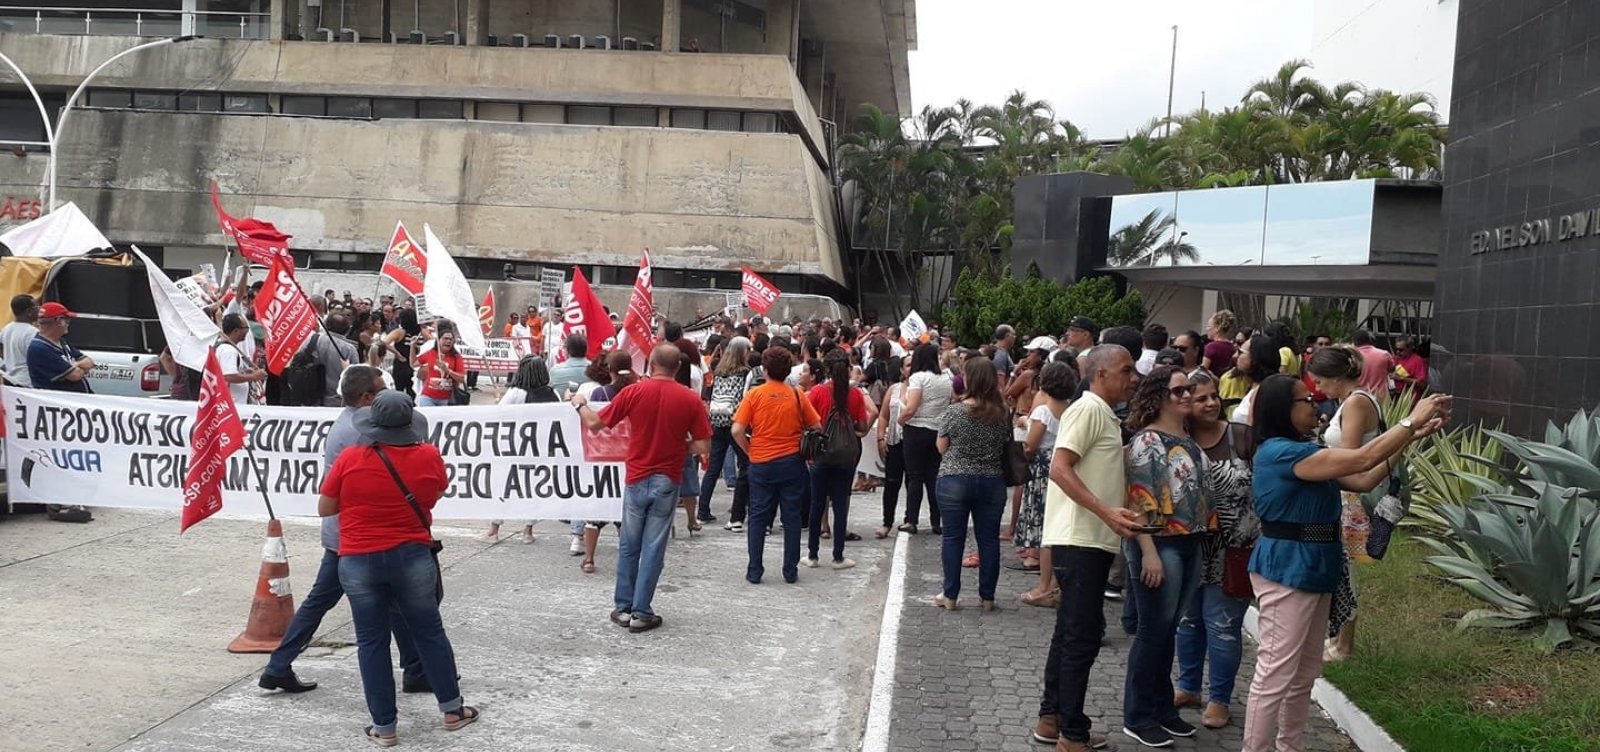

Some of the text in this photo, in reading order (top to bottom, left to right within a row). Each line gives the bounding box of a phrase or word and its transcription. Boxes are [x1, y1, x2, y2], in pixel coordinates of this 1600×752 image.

[0, 195, 41, 220] ÃES
[1495, 218, 1551, 250] NELSON
[564, 292, 588, 336] NDE
